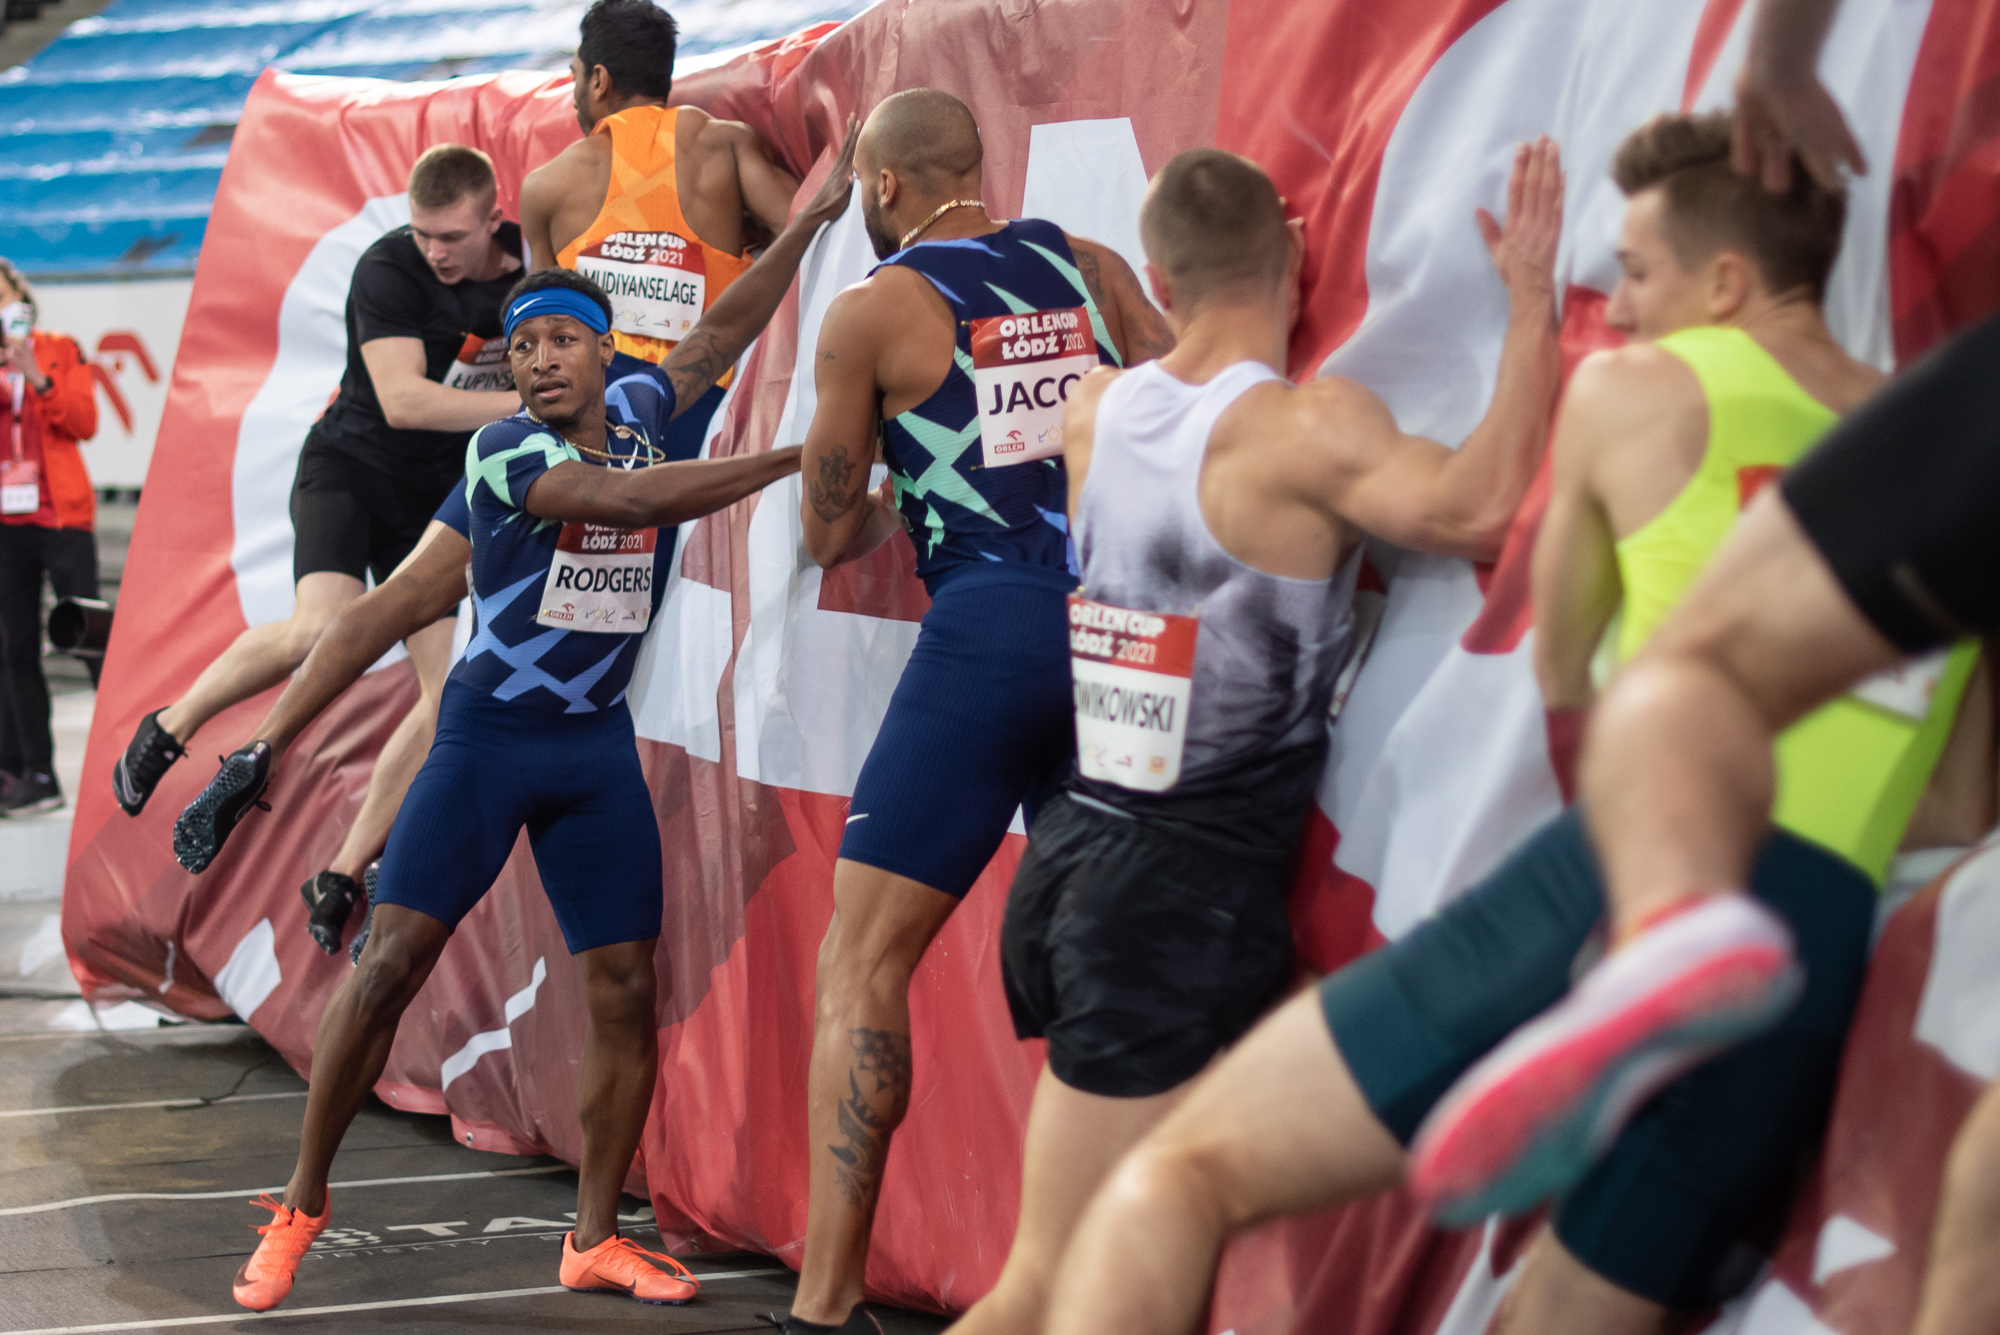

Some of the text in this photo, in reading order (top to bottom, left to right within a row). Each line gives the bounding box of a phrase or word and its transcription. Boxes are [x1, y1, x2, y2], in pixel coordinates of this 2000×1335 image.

[604, 231, 688, 249] ORLEN CUP
[600, 242, 684, 265] ŁÓDŹ 2021
[999, 312, 1079, 338] ORLEN CUP
[1002, 331, 1087, 360] ŁÓDŹ 2021
[996, 443, 1024, 453] ORLEN
[581, 531, 643, 550] ŁÓDŹ 2021
[555, 564, 652, 593] RODGERS
[1069, 603, 1166, 639] ORLEN CUP
[1116, 638, 1158, 664] 2021
